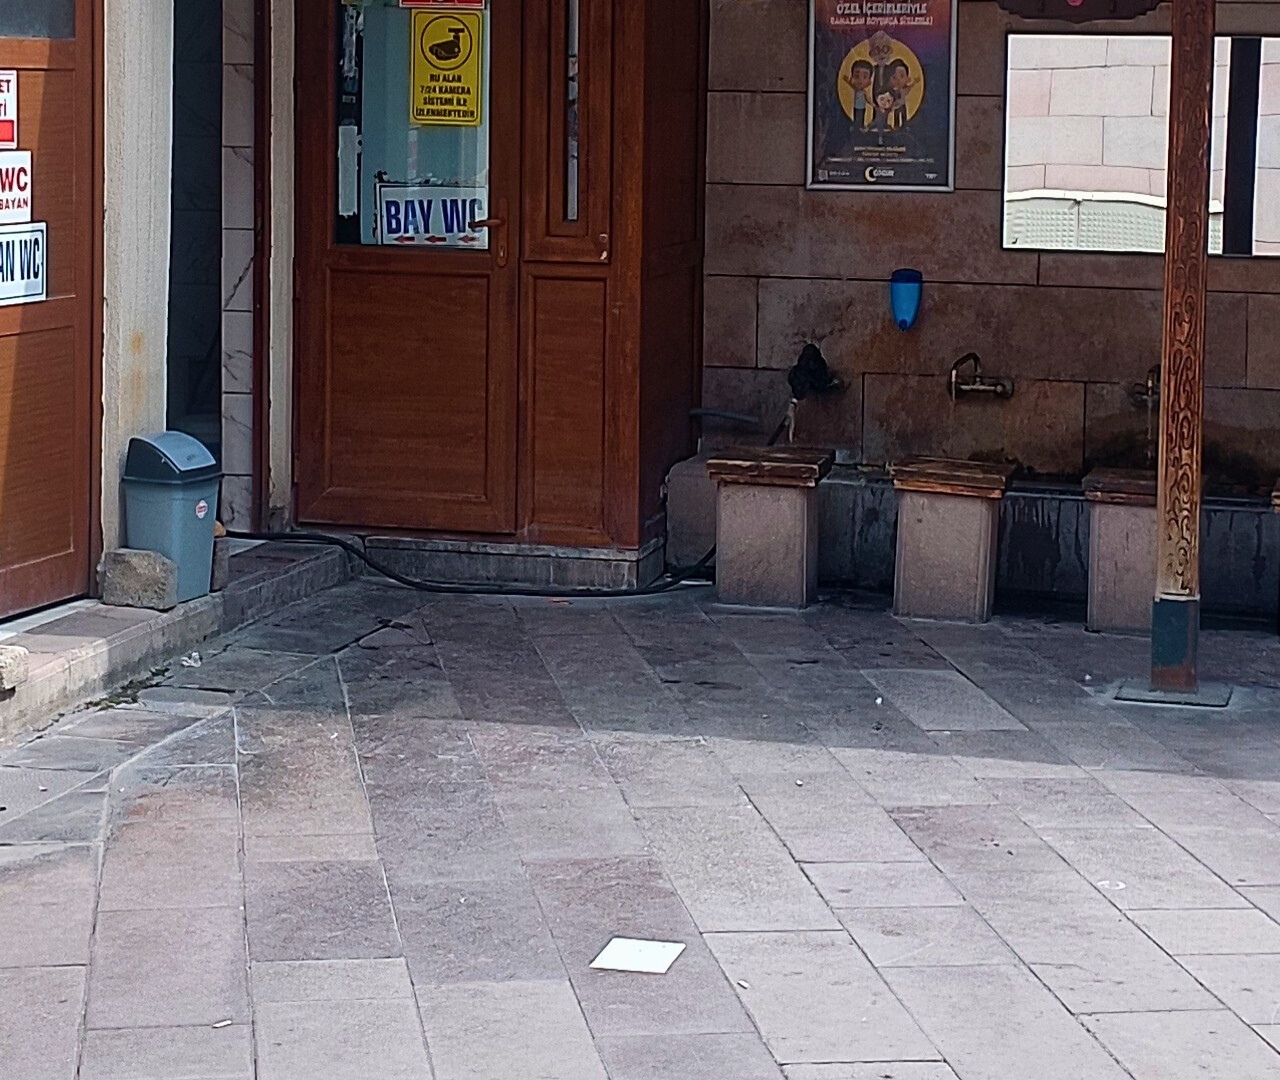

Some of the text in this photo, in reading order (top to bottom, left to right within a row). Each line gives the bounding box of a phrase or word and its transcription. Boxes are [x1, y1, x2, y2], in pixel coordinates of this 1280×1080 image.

[385, 197, 483, 235] BAY WC
[19, 237, 40, 281] WC
